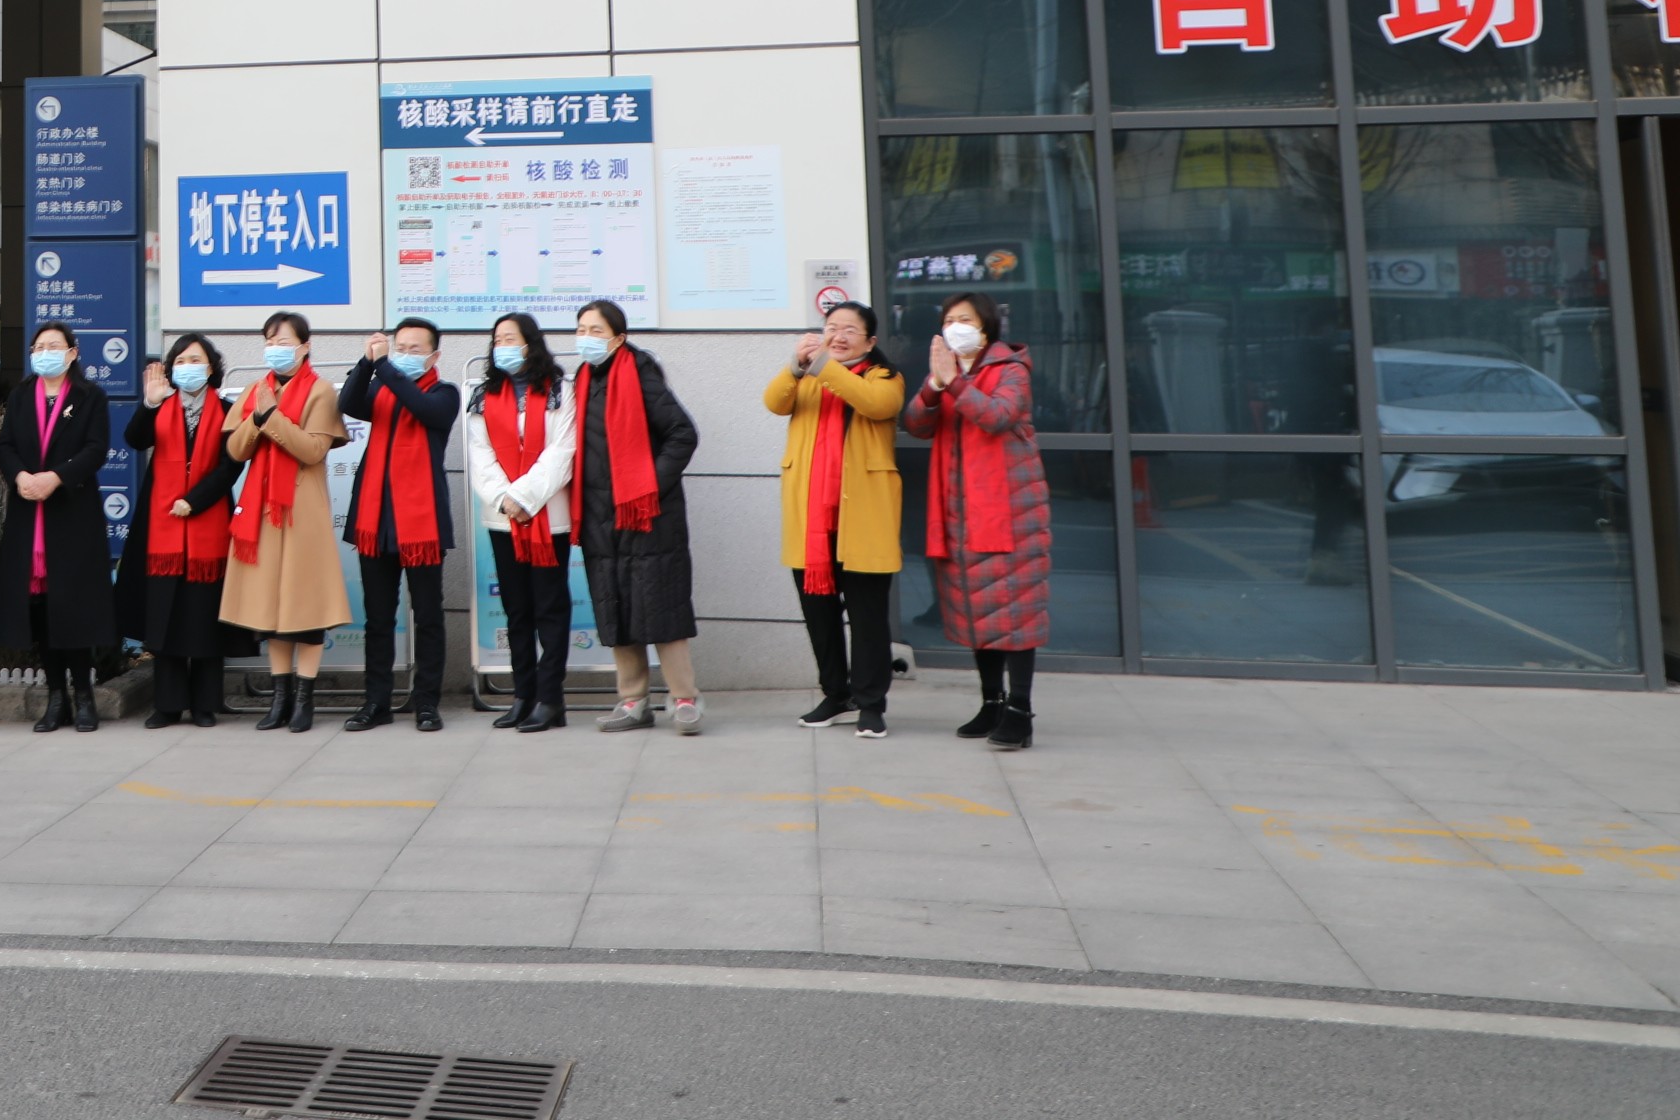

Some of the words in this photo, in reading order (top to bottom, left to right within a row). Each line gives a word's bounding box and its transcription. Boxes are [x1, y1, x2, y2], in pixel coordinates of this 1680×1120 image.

[397, 92, 639, 129] 核酸采样请前行直走
[36, 127, 99, 140] 行政办公楼
[36, 152, 86, 165] 肠道门诊
[525, 157, 629, 182] 核酸检测
[36, 177, 86, 189] 发热门诊
[36, 200, 123, 214] 感染性疾病门诊
[189, 189, 340, 256] 地下停车入口
[36, 280, 75, 293] 诚信楼
[36, 303, 75, 317] 博爱楼
[85, 365, 112, 379] 急诊
